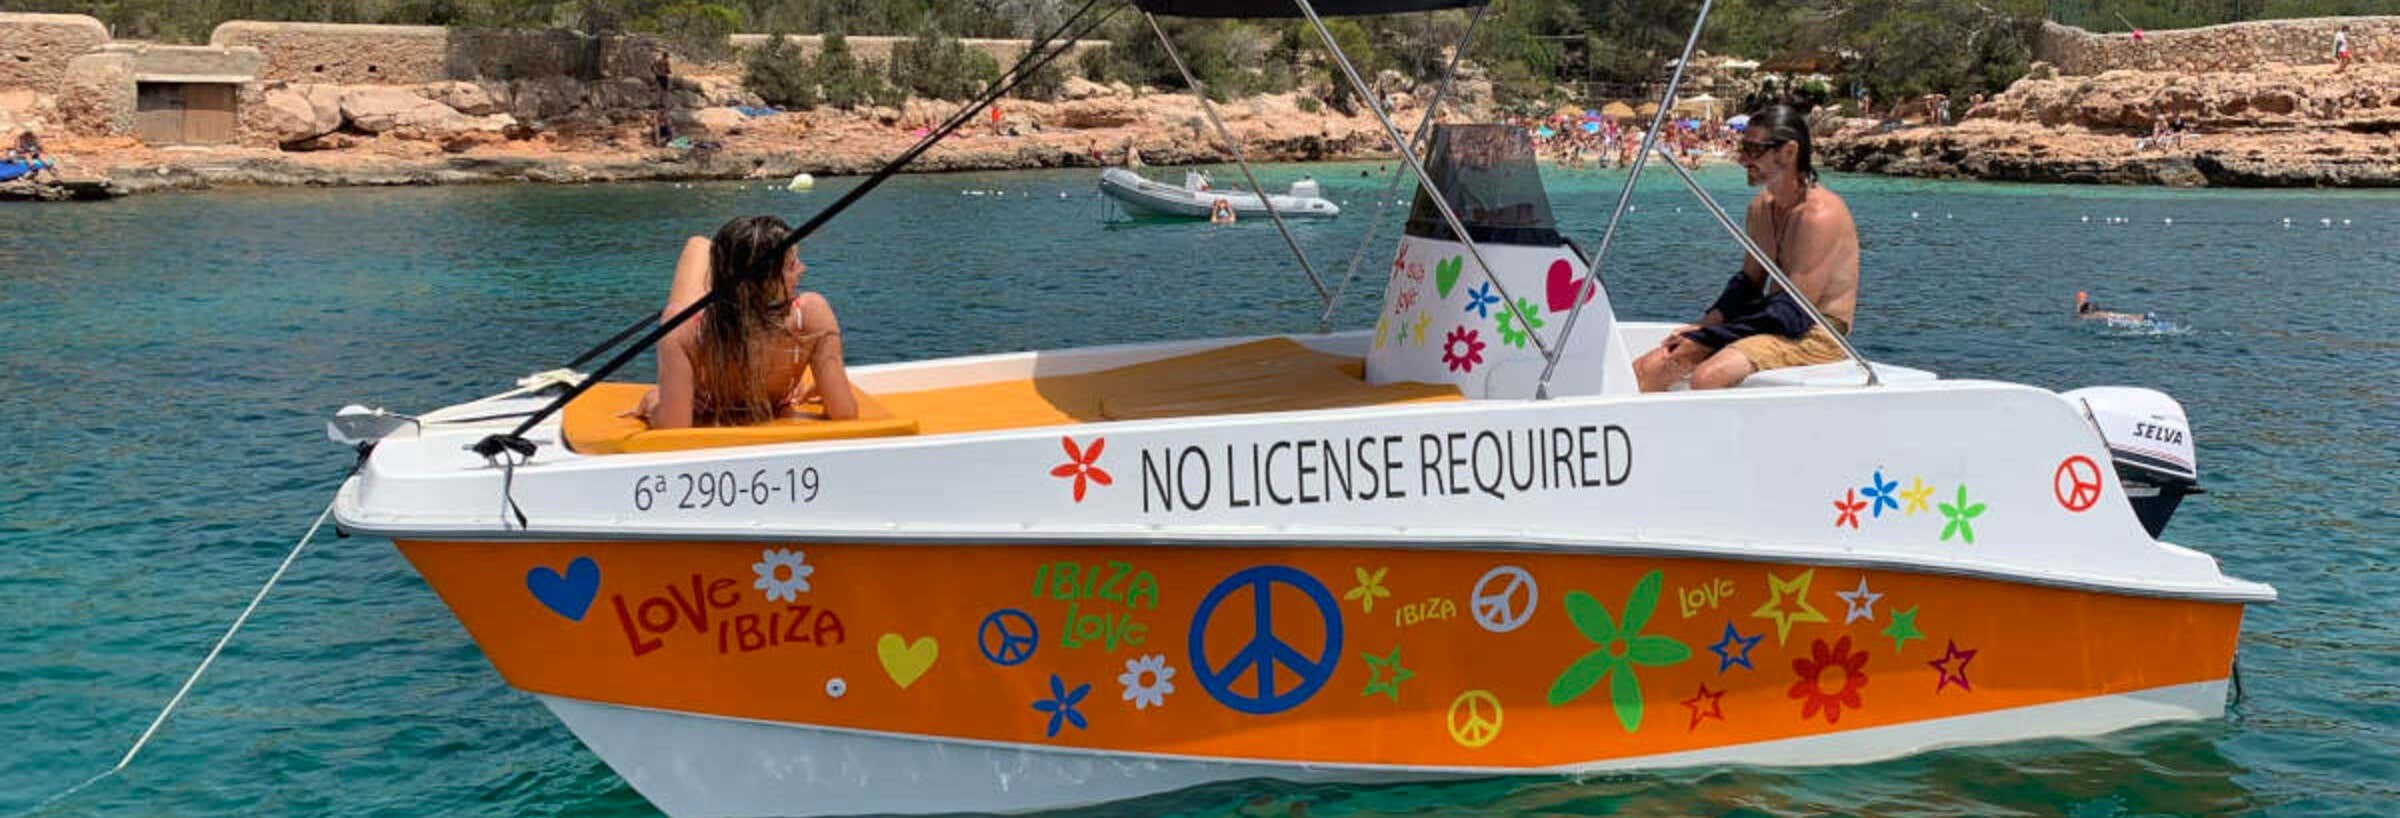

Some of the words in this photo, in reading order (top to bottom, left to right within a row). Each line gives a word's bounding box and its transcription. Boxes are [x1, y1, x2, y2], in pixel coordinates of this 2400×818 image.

[2132, 421, 2183, 446] SELVA
[677, 466, 820, 509] 290-6-19
[1141, 445, 1212, 513] NO
[1227, 435, 1407, 509] LICENSE
[1419, 424, 1633, 500] REQUIRED
[1032, 560, 1159, 610] IBIZA
[718, 604, 846, 656] IBIZA
[1394, 597, 1457, 628] IBIZA
